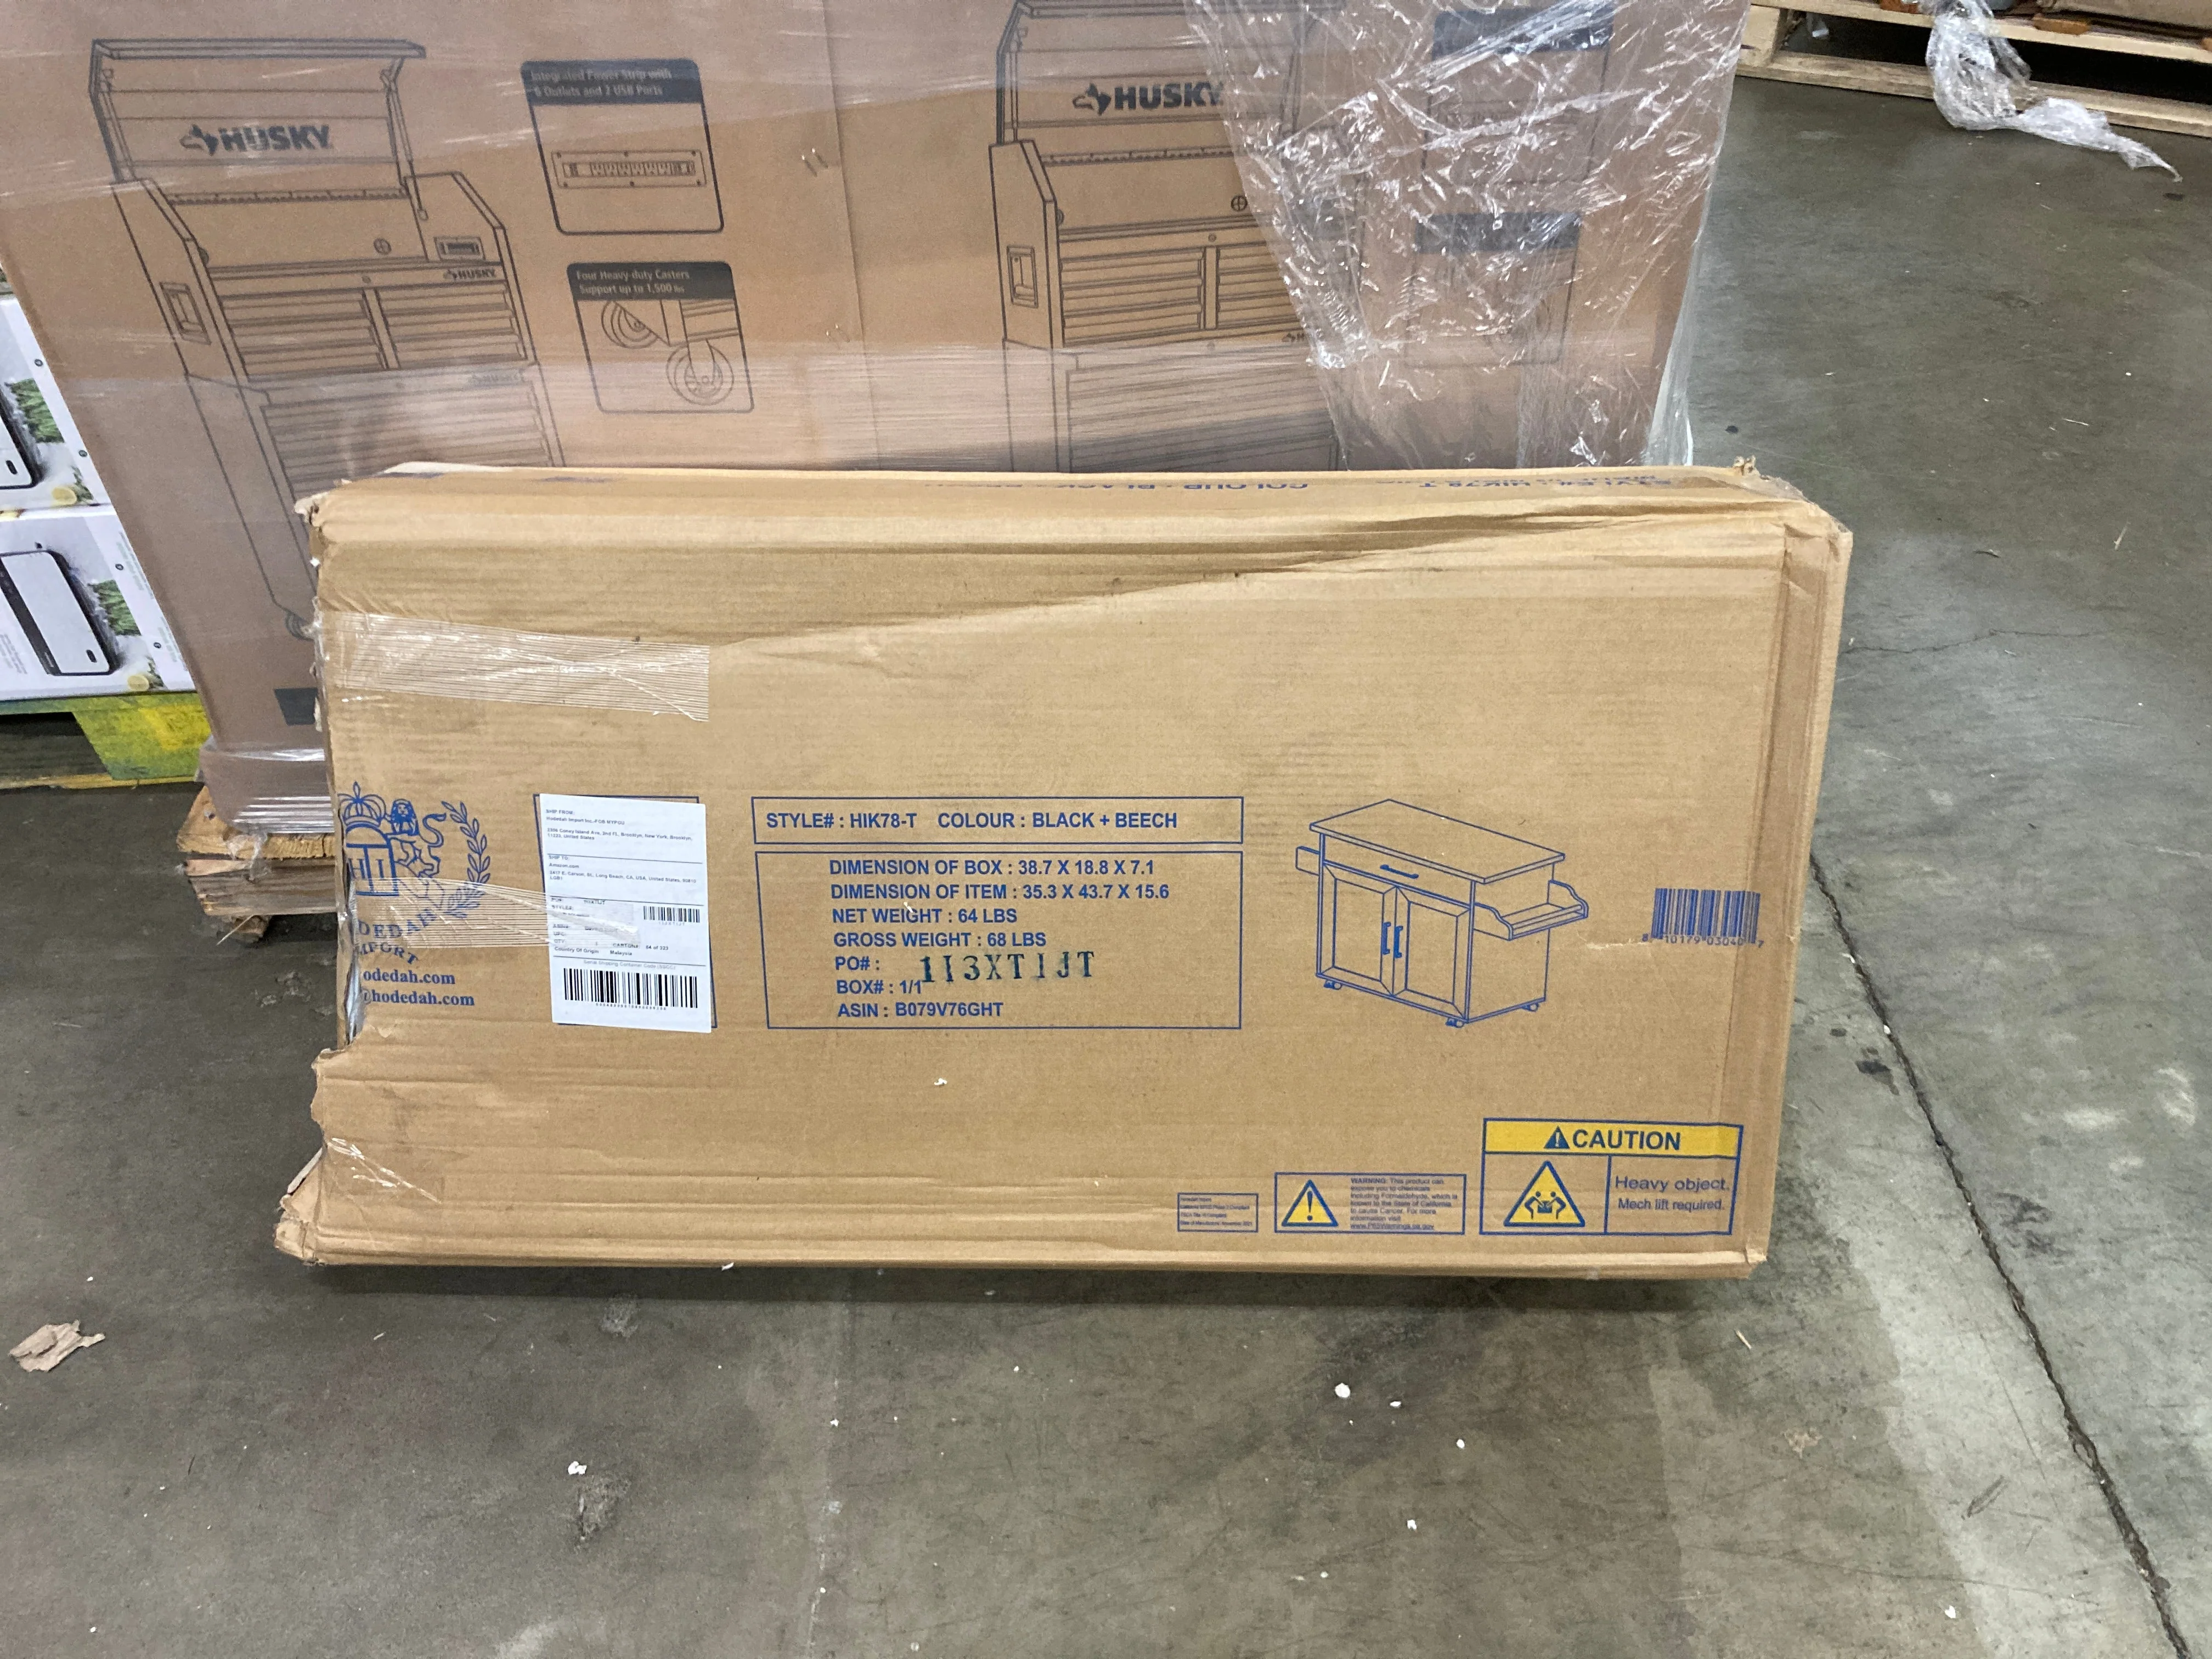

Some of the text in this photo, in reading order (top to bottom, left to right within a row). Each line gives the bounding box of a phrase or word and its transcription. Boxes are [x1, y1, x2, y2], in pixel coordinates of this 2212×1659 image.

[1114, 81, 1223, 110] HUSKY
[218, 125, 331, 152] HUSKY
[577, 269, 690, 280] Four Casters
[579, 284, 616, 296] Support
[619, 285, 631, 296] up
[634, 284, 644, 294] to
[766, 812, 834, 828] STYLE#
[850, 812, 918, 828] HIK78-T
[938, 812, 1014, 828] COLOUR
[1032, 812, 1094, 828] BLACK
[1099, 814, 1110, 826] +
[1115, 812, 1177, 828] BEECH
[829, 860, 929, 874] DIMENSION
[935, 860, 958, 874] OF
[964, 860, 1002, 874] BOX
[1018, 860, 1052, 874] 38.7
[1057, 860, 1070, 874] X
[1075, 860, 1109, 874] 18.8
[1114, 860, 1126, 874] X
[1131, 860, 1154, 874] 7.1
[831, 884, 930, 899] DIMENSION
[936, 884, 960, 899] OF
[966, 884, 1007, 899] ITEM
[1023, 884, 1057, 899] 35.3
[1062, 884, 1074, 899] X
[1079, 884, 1113, 899] 43.7
[1118, 884, 1130, 899] X
[1135, 884, 1170, 899] 15.6
[358, 909, 438, 938] DEDAH
[832, 909, 867, 923] NET
[872, 909, 943, 923] WEIGHT
[958, 909, 978, 923] 64
[983, 909, 1017, 923] LBS
[833, 932, 896, 947] GROSS
[901, 932, 972, 947] WEIGHT
[988, 932, 1006, 947] 68
[1012, 932, 1046, 947] LBS
[834, 956, 870, 970] PO#
[363, 967, 455, 985] odedah.com
[837, 980, 884, 994] BOX#
[900, 980, 922, 994] 1/1
[838, 1003, 878, 1017] ASIN
[896, 1002, 1003, 1017] B079V76GHT
[1572, 1128, 1681, 1150] CAUTION
[1615, 1176, 1730, 1192] Heavy object.
[1618, 1198, 1651, 1210] Mech
[1655, 1198, 1668, 1210] lift
